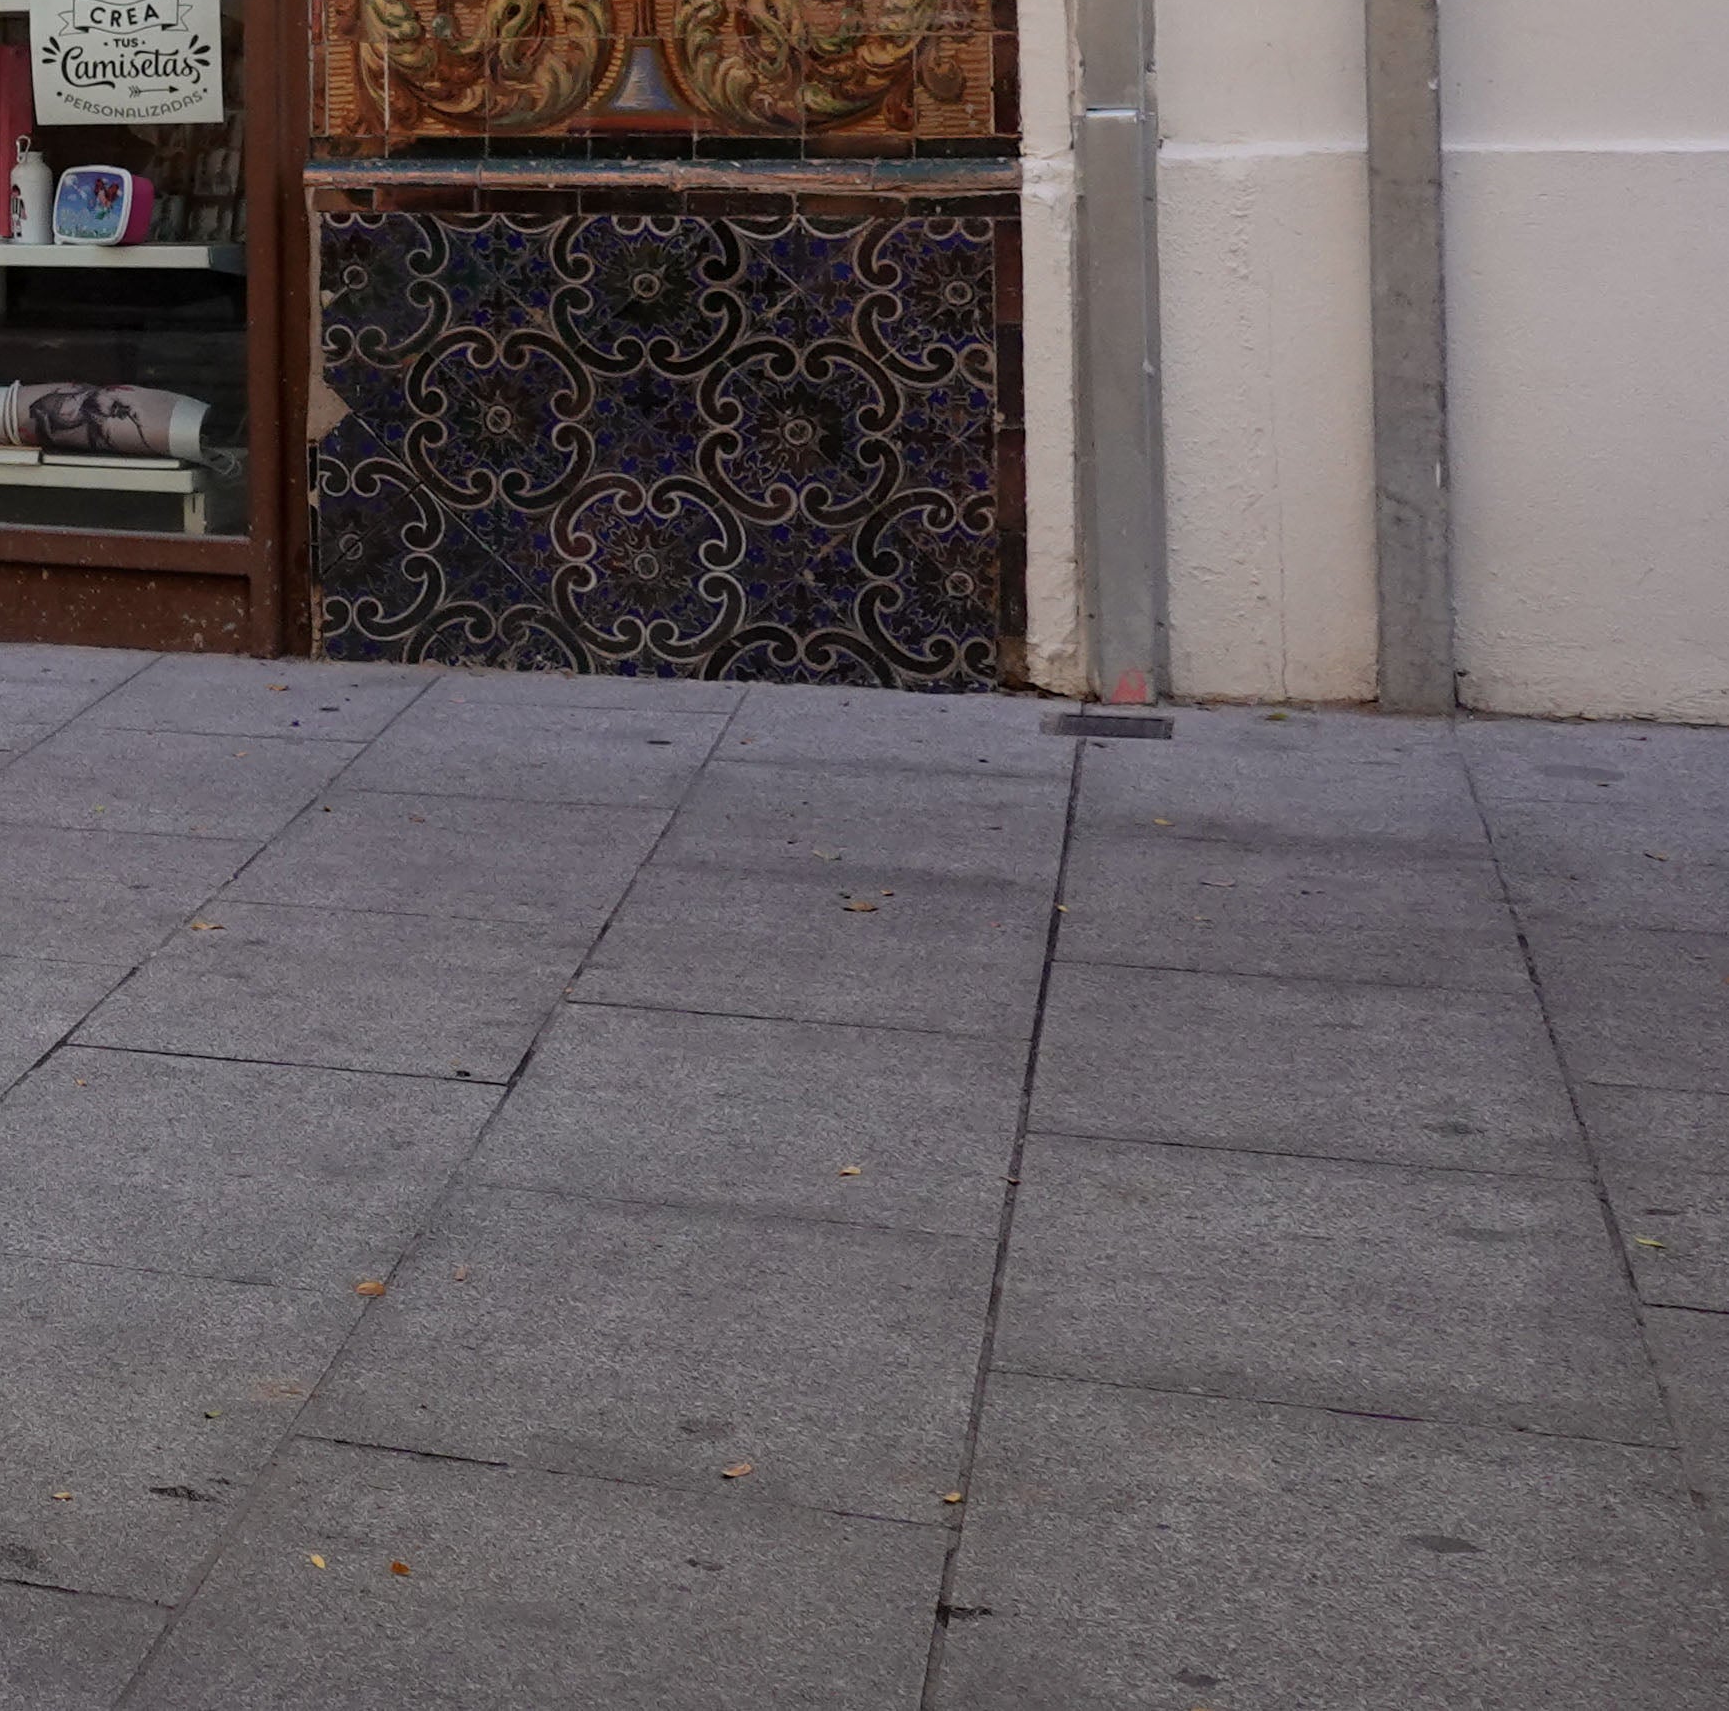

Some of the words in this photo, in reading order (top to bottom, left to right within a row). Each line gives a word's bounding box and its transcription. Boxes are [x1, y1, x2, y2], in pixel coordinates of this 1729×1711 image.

[89, 3, 160, 28] CREA
[112, 38, 139, 48] TUS
[61, 45, 201, 89] Camisetas
[63, 90, 204, 119] PERSONALIZADAS
